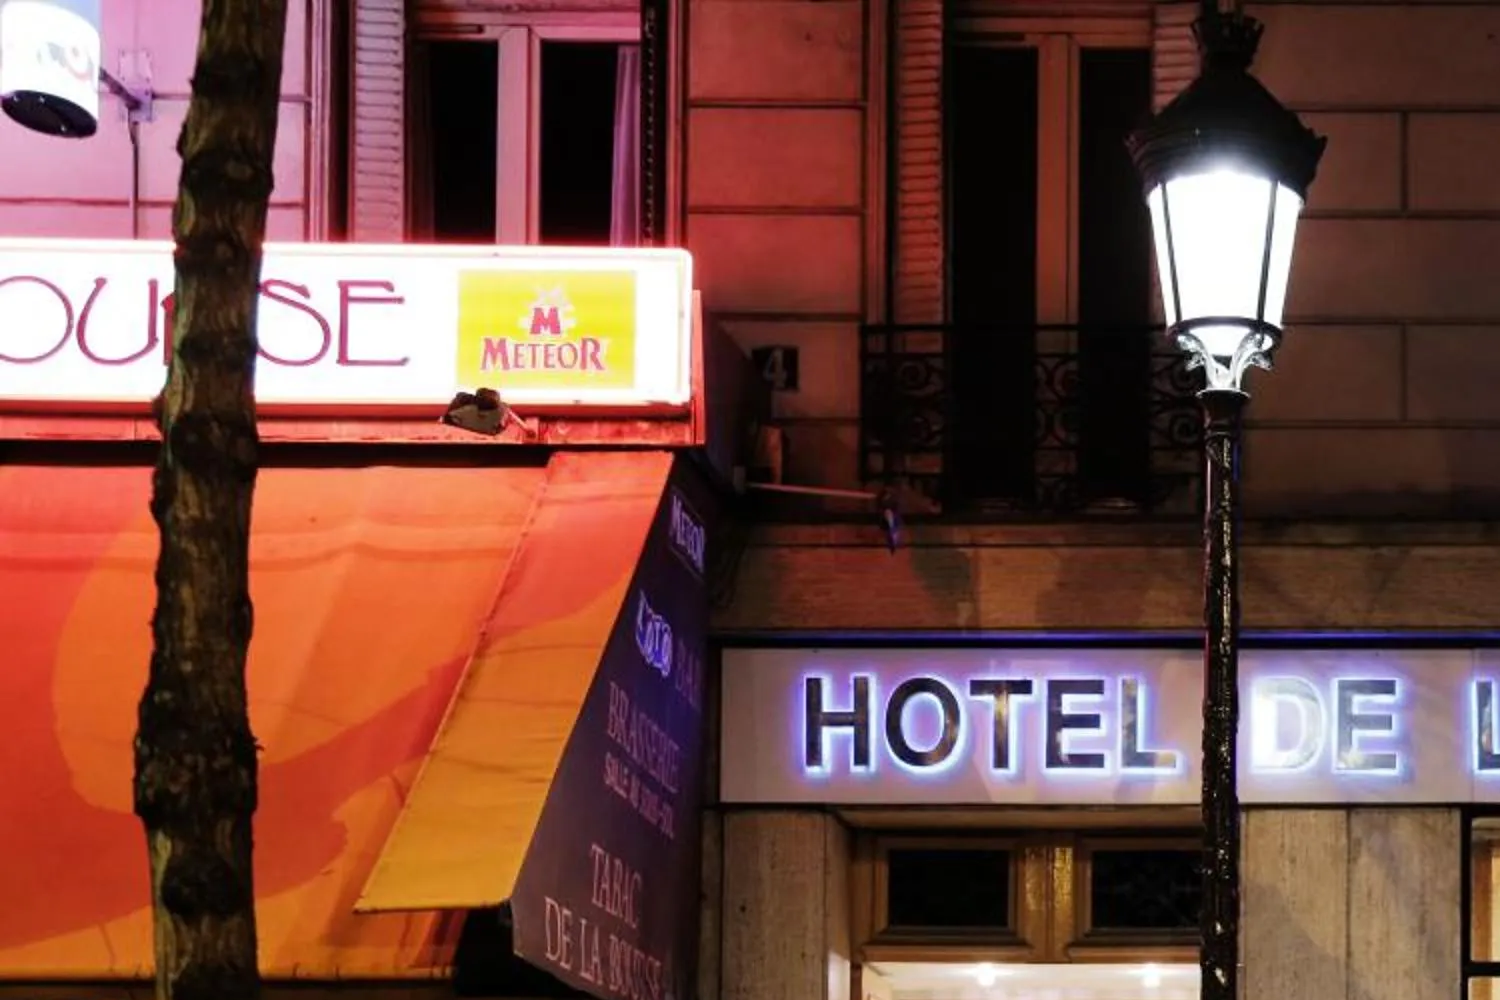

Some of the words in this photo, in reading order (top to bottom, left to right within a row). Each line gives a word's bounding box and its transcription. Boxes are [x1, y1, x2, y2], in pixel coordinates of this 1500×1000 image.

[0, 275, 409, 366] OUSE
[480, 337, 605, 371] METEOR
[530, 307, 561, 335] M
[607, 681, 680, 793] BRASSERIE
[803, 674, 1178, 772] HOTEL
[1251, 676, 1400, 772] DE
[589, 843, 643, 929] TABAC
[544, 896, 573, 970] DE
[580, 918, 603, 988] LA
